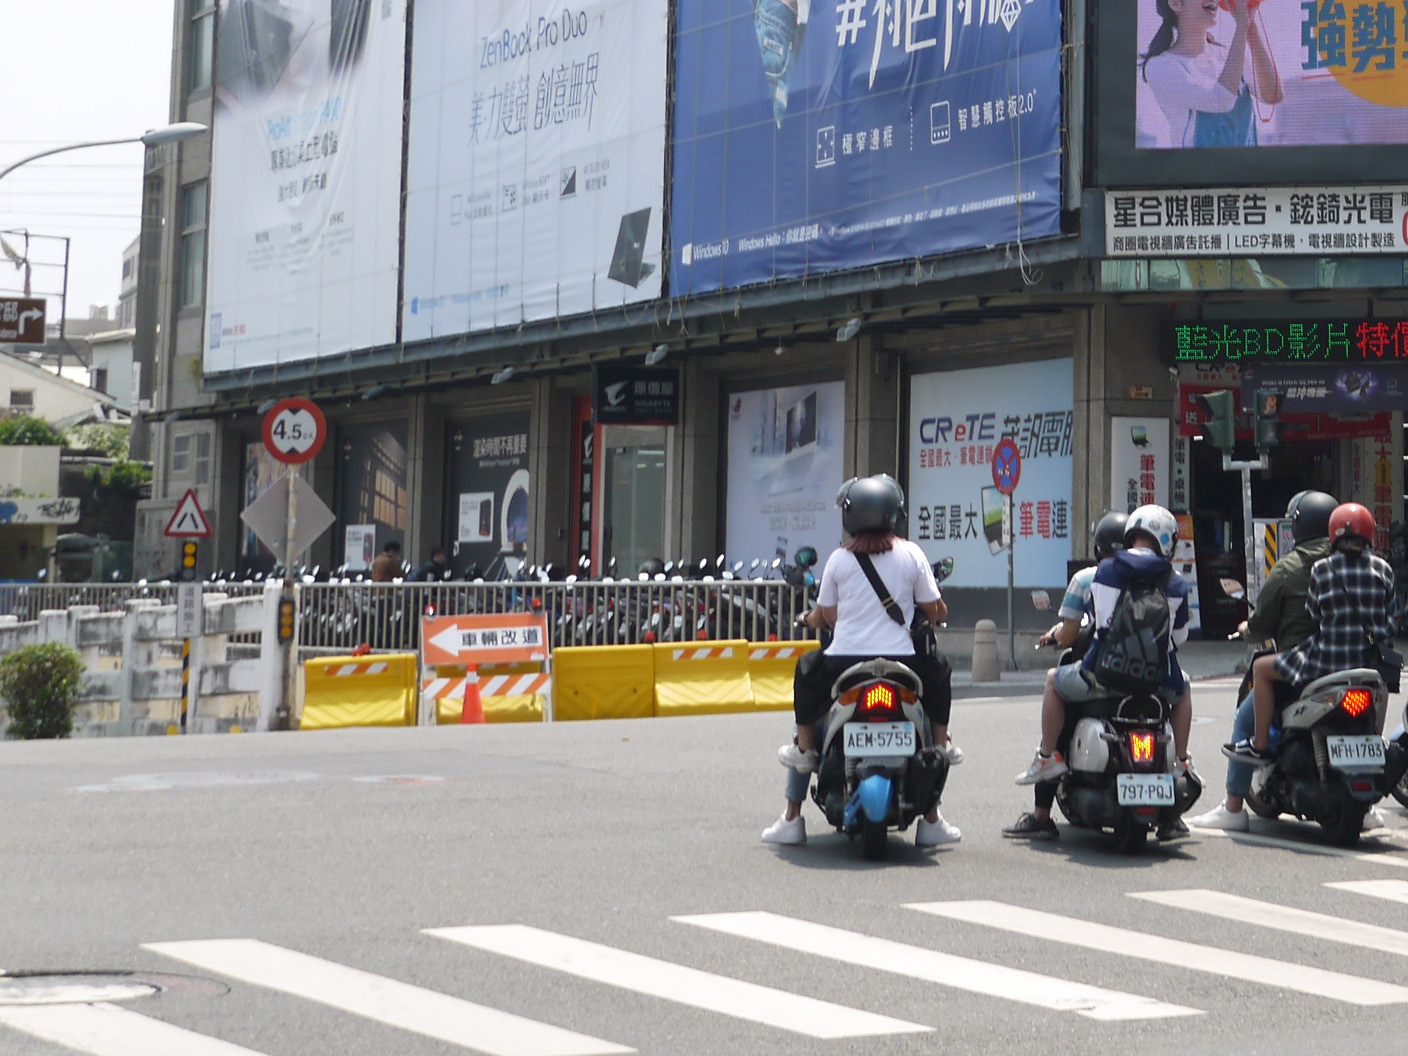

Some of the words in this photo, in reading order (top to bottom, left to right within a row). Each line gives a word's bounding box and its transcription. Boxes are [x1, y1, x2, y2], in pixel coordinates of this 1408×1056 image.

[480, 20, 532, 70] ZenBook
[537, 16, 558, 50] Pro
[562, 8, 588, 41] Duo
[273, 419, 303, 440] 4.5
[917, 505, 978, 541] 全國最大
[461, 628, 539, 647] 車輛改道
[1102, 651, 1166, 682] adidas
[847, 731, 914, 748] AEM-5755
